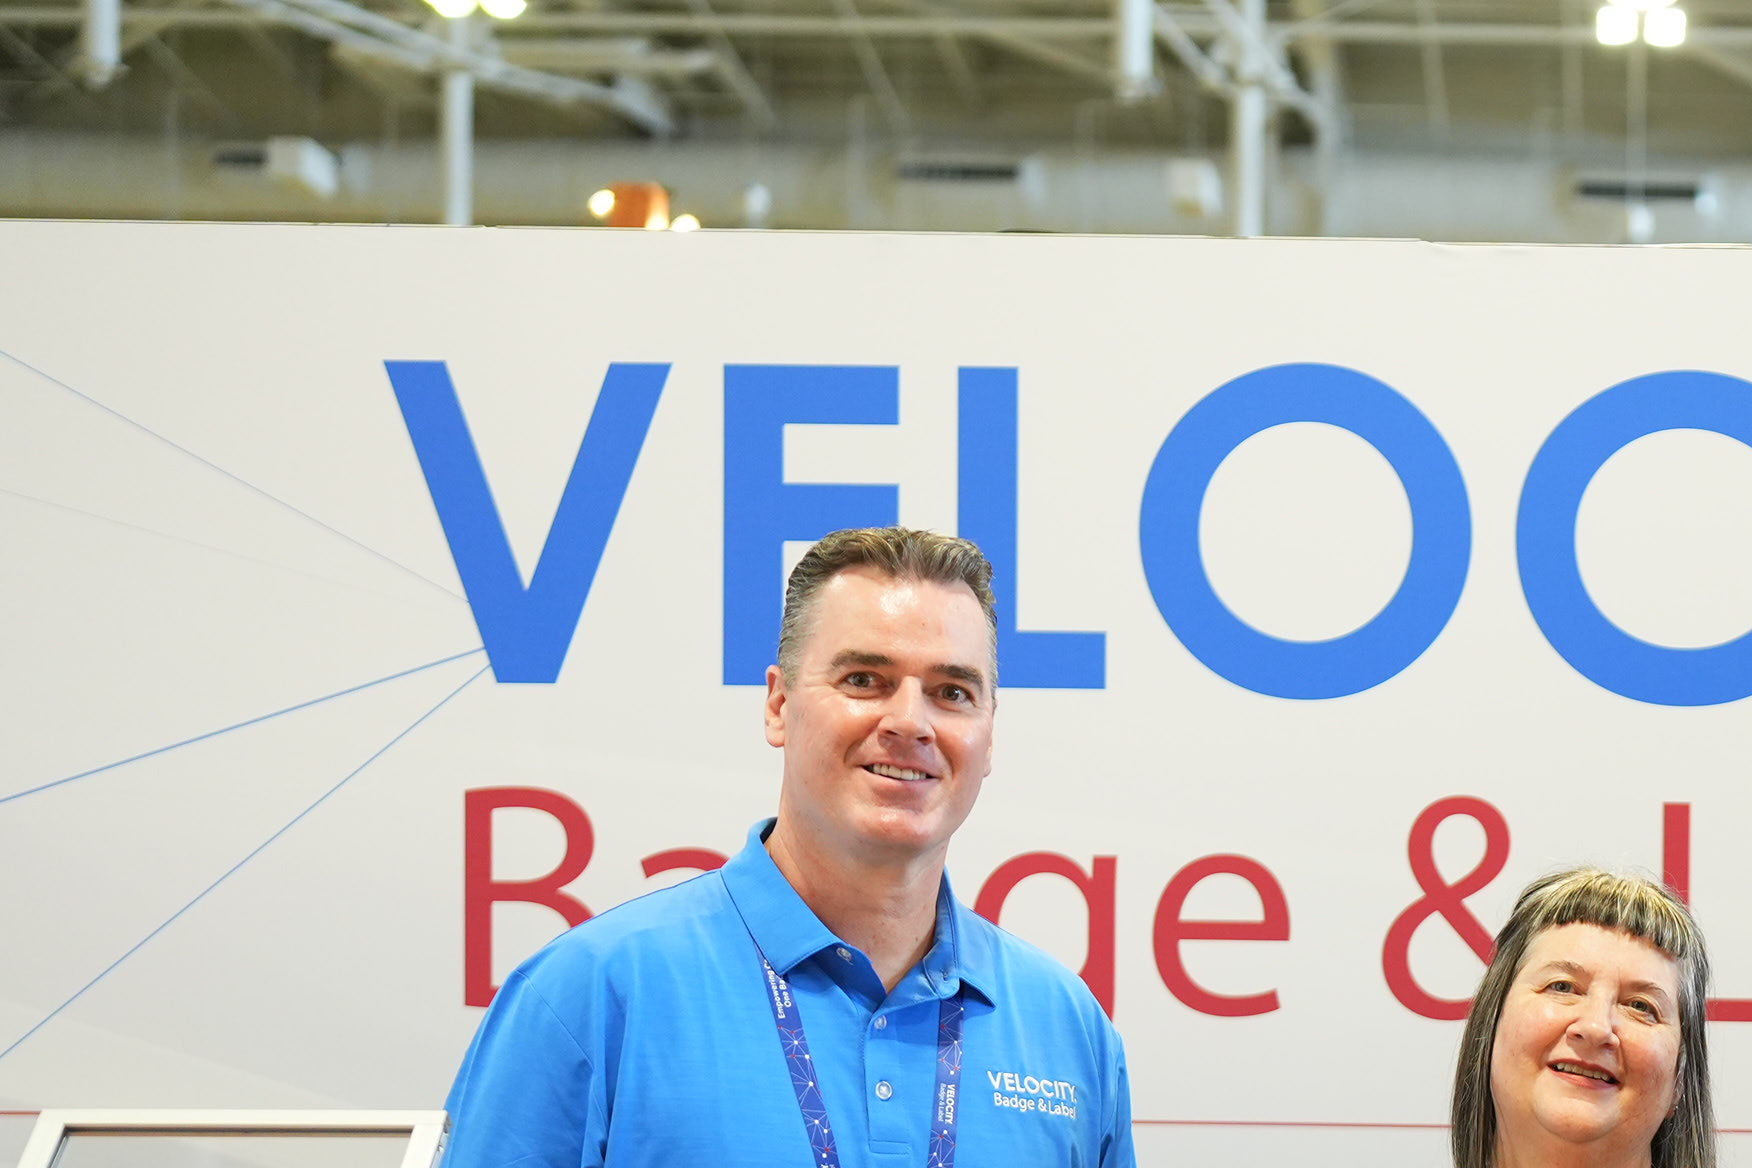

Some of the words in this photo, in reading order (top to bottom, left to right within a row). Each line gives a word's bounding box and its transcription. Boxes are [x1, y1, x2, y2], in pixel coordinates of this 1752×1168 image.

[1382, 794, 1512, 1020] &
[768, 971, 786, 1019] Empowering
[784, 995, 792, 1008] One
[944, 1084, 955, 1124] VELOCITY
[994, 1092, 1035, 1112] Badge
[1038, 1098, 1048, 1112] &
[1048, 1100, 1077, 1119] Label
